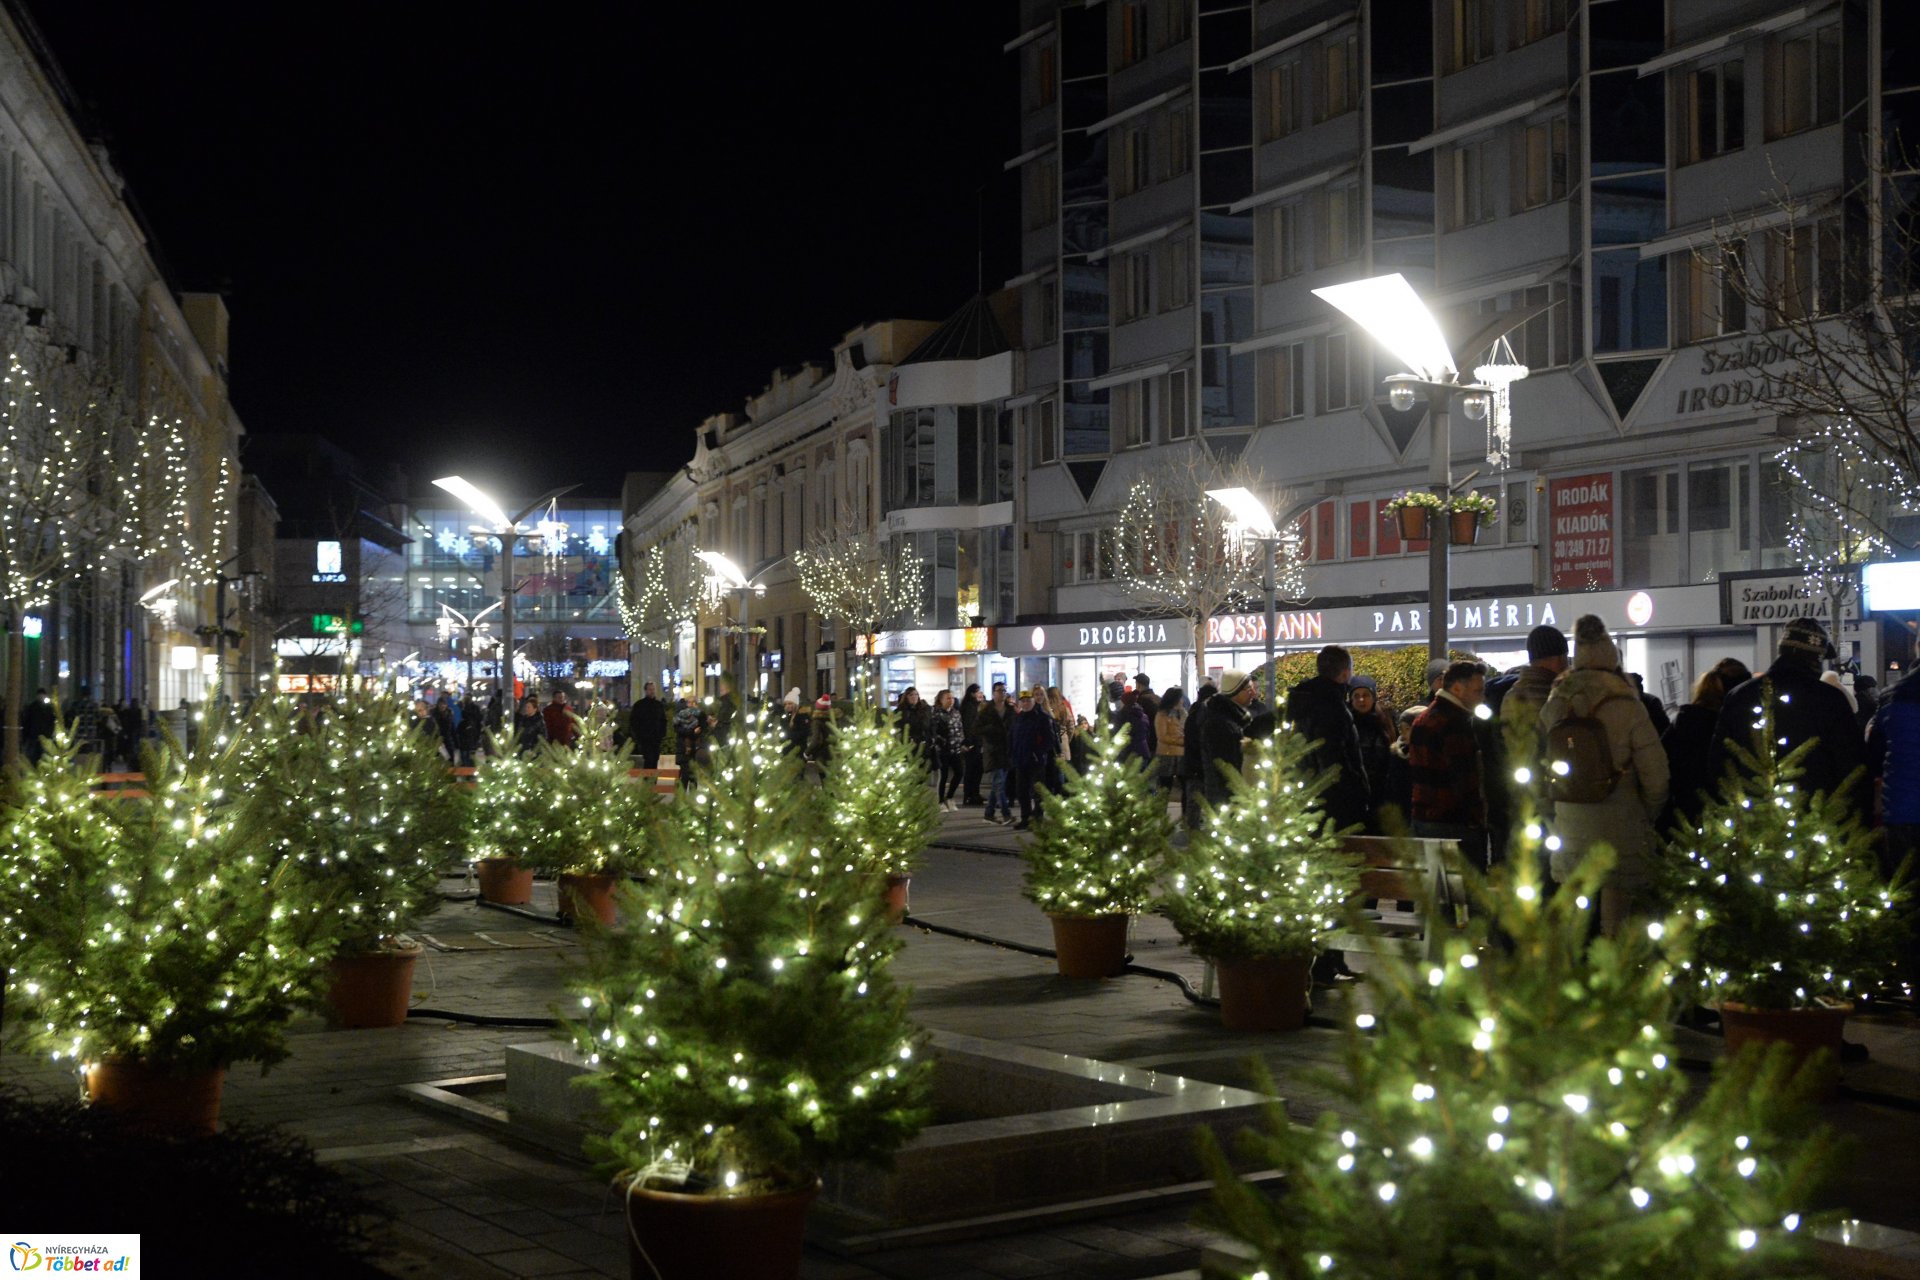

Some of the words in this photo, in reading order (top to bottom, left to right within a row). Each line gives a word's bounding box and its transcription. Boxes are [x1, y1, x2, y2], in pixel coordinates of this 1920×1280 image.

[1557, 481, 1608, 506] IRODÁK
[1557, 509, 1608, 534] KIADÓK
[1586, 539, 1596, 556] 71
[1599, 537, 1610, 555] 27
[1374, 600, 1556, 632] PARÜMÉRIA
[1743, 597, 1852, 620] IRODAHÁ
[1079, 621, 1167, 646] DROGÉRIA
